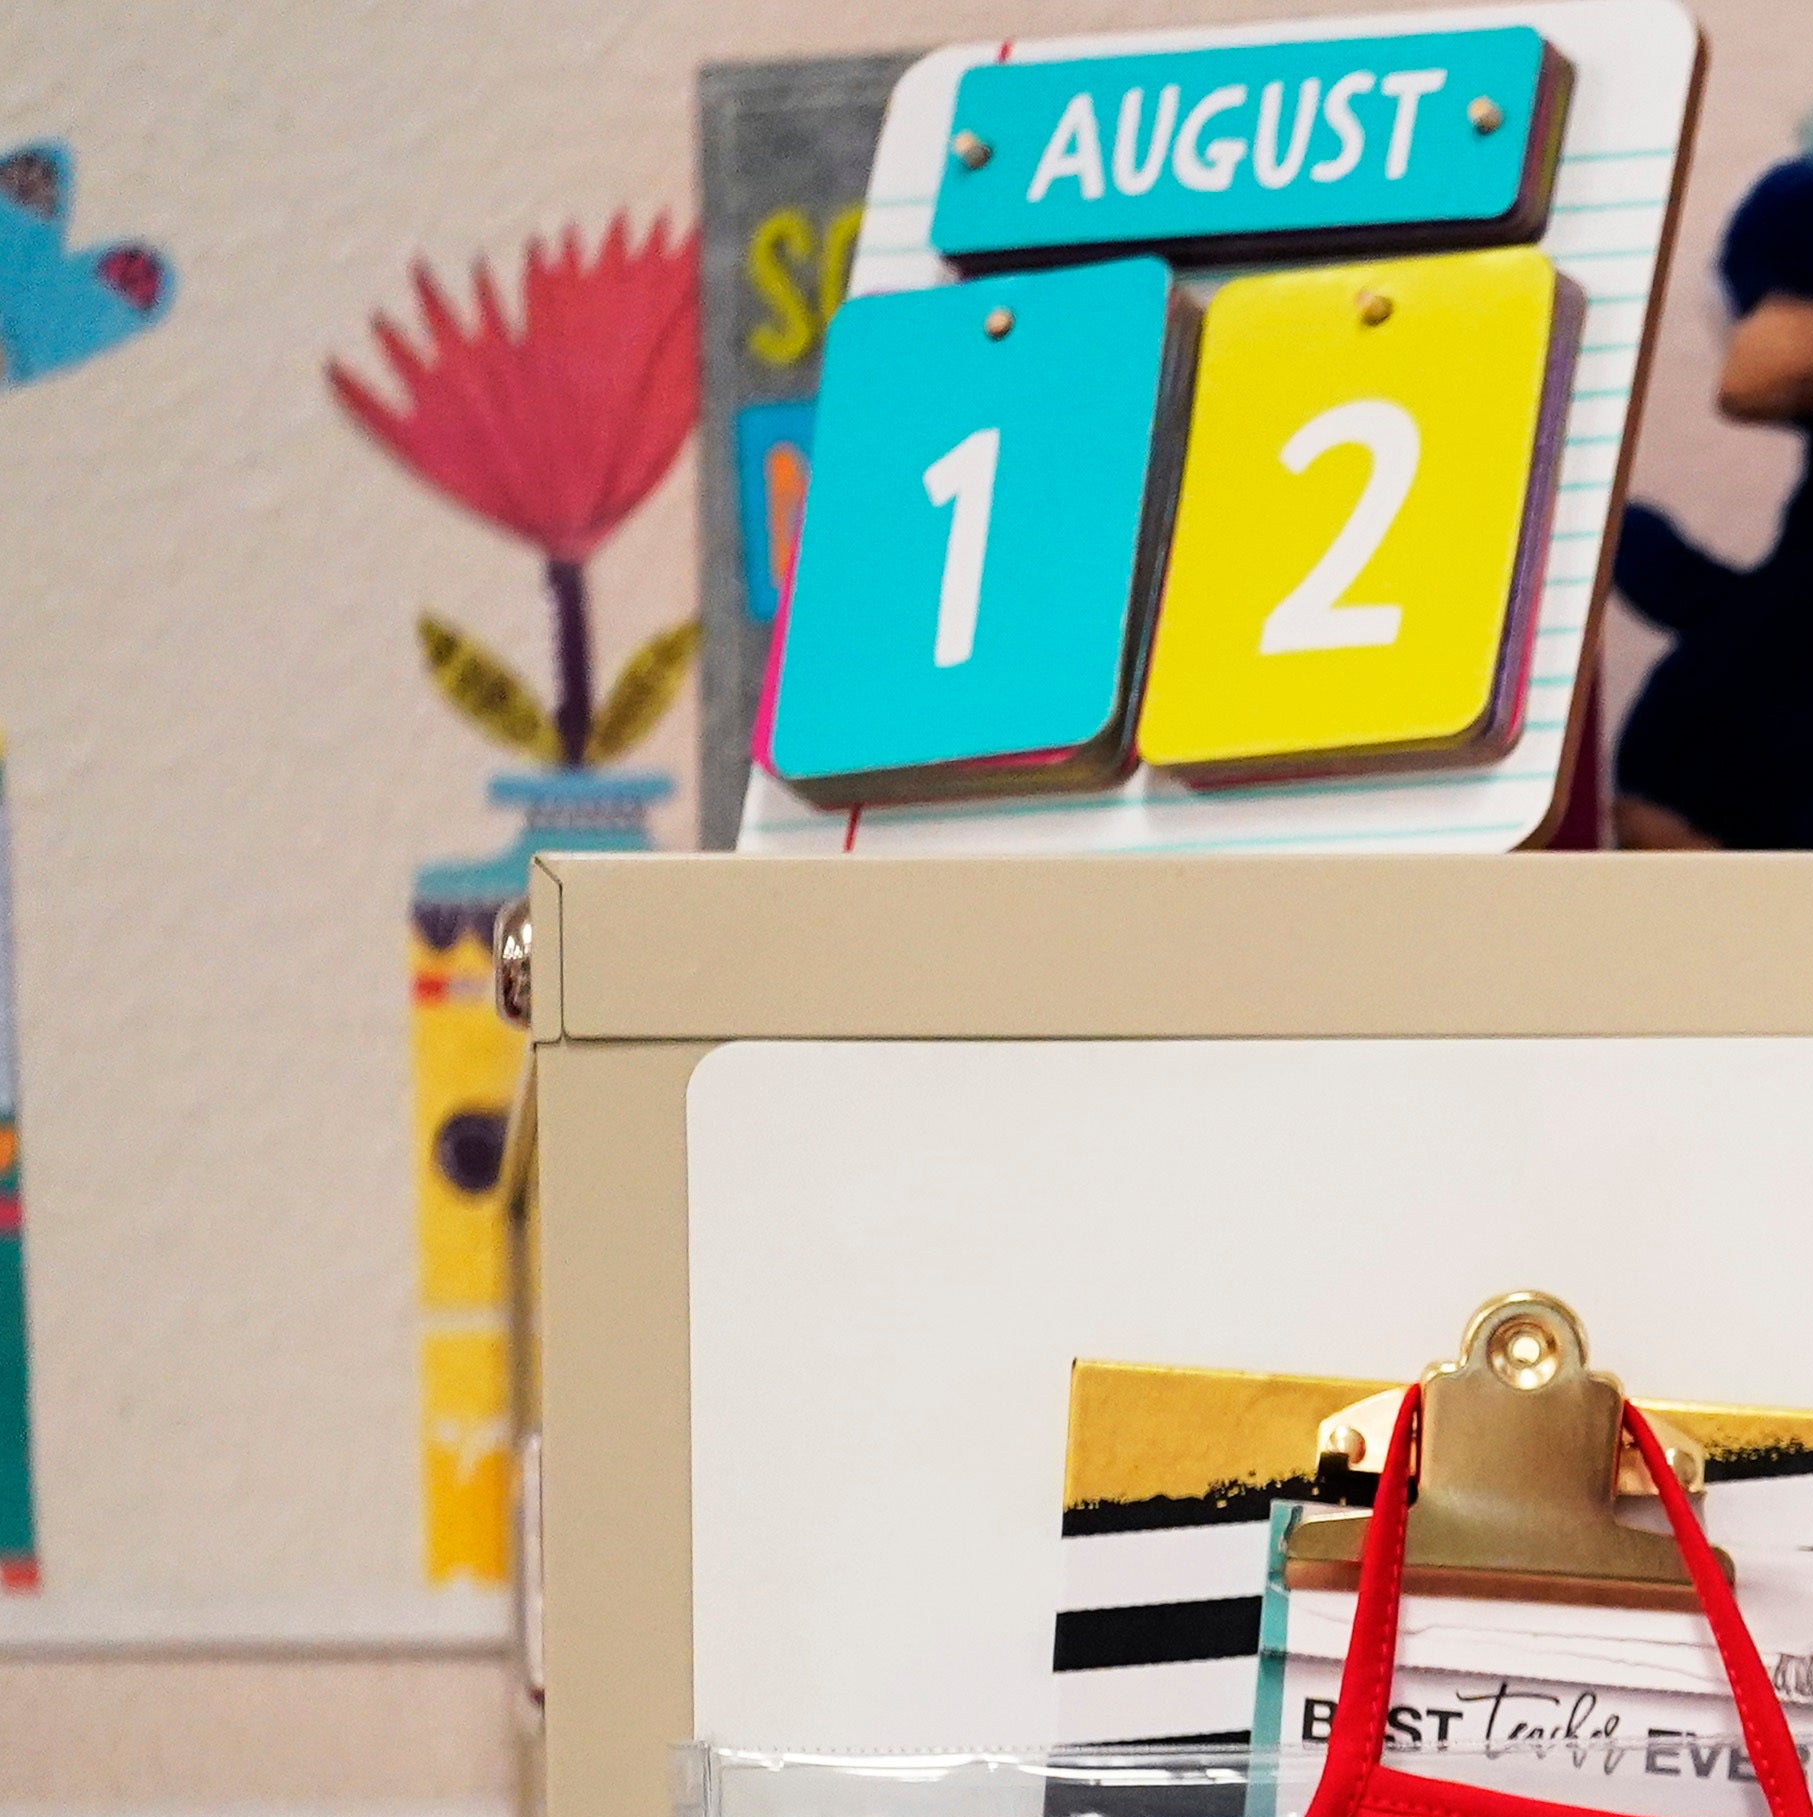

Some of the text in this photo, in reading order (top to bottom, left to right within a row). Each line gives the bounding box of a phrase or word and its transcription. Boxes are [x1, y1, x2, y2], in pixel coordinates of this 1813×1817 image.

[1026, 68, 1447, 203] AUGUST
[922, 426, 1000, 668] 1
[1258, 397, 1422, 657] 2
[1302, 1697, 1463, 1752] BST
[1645, 1728, 1811, 1783] EVE
